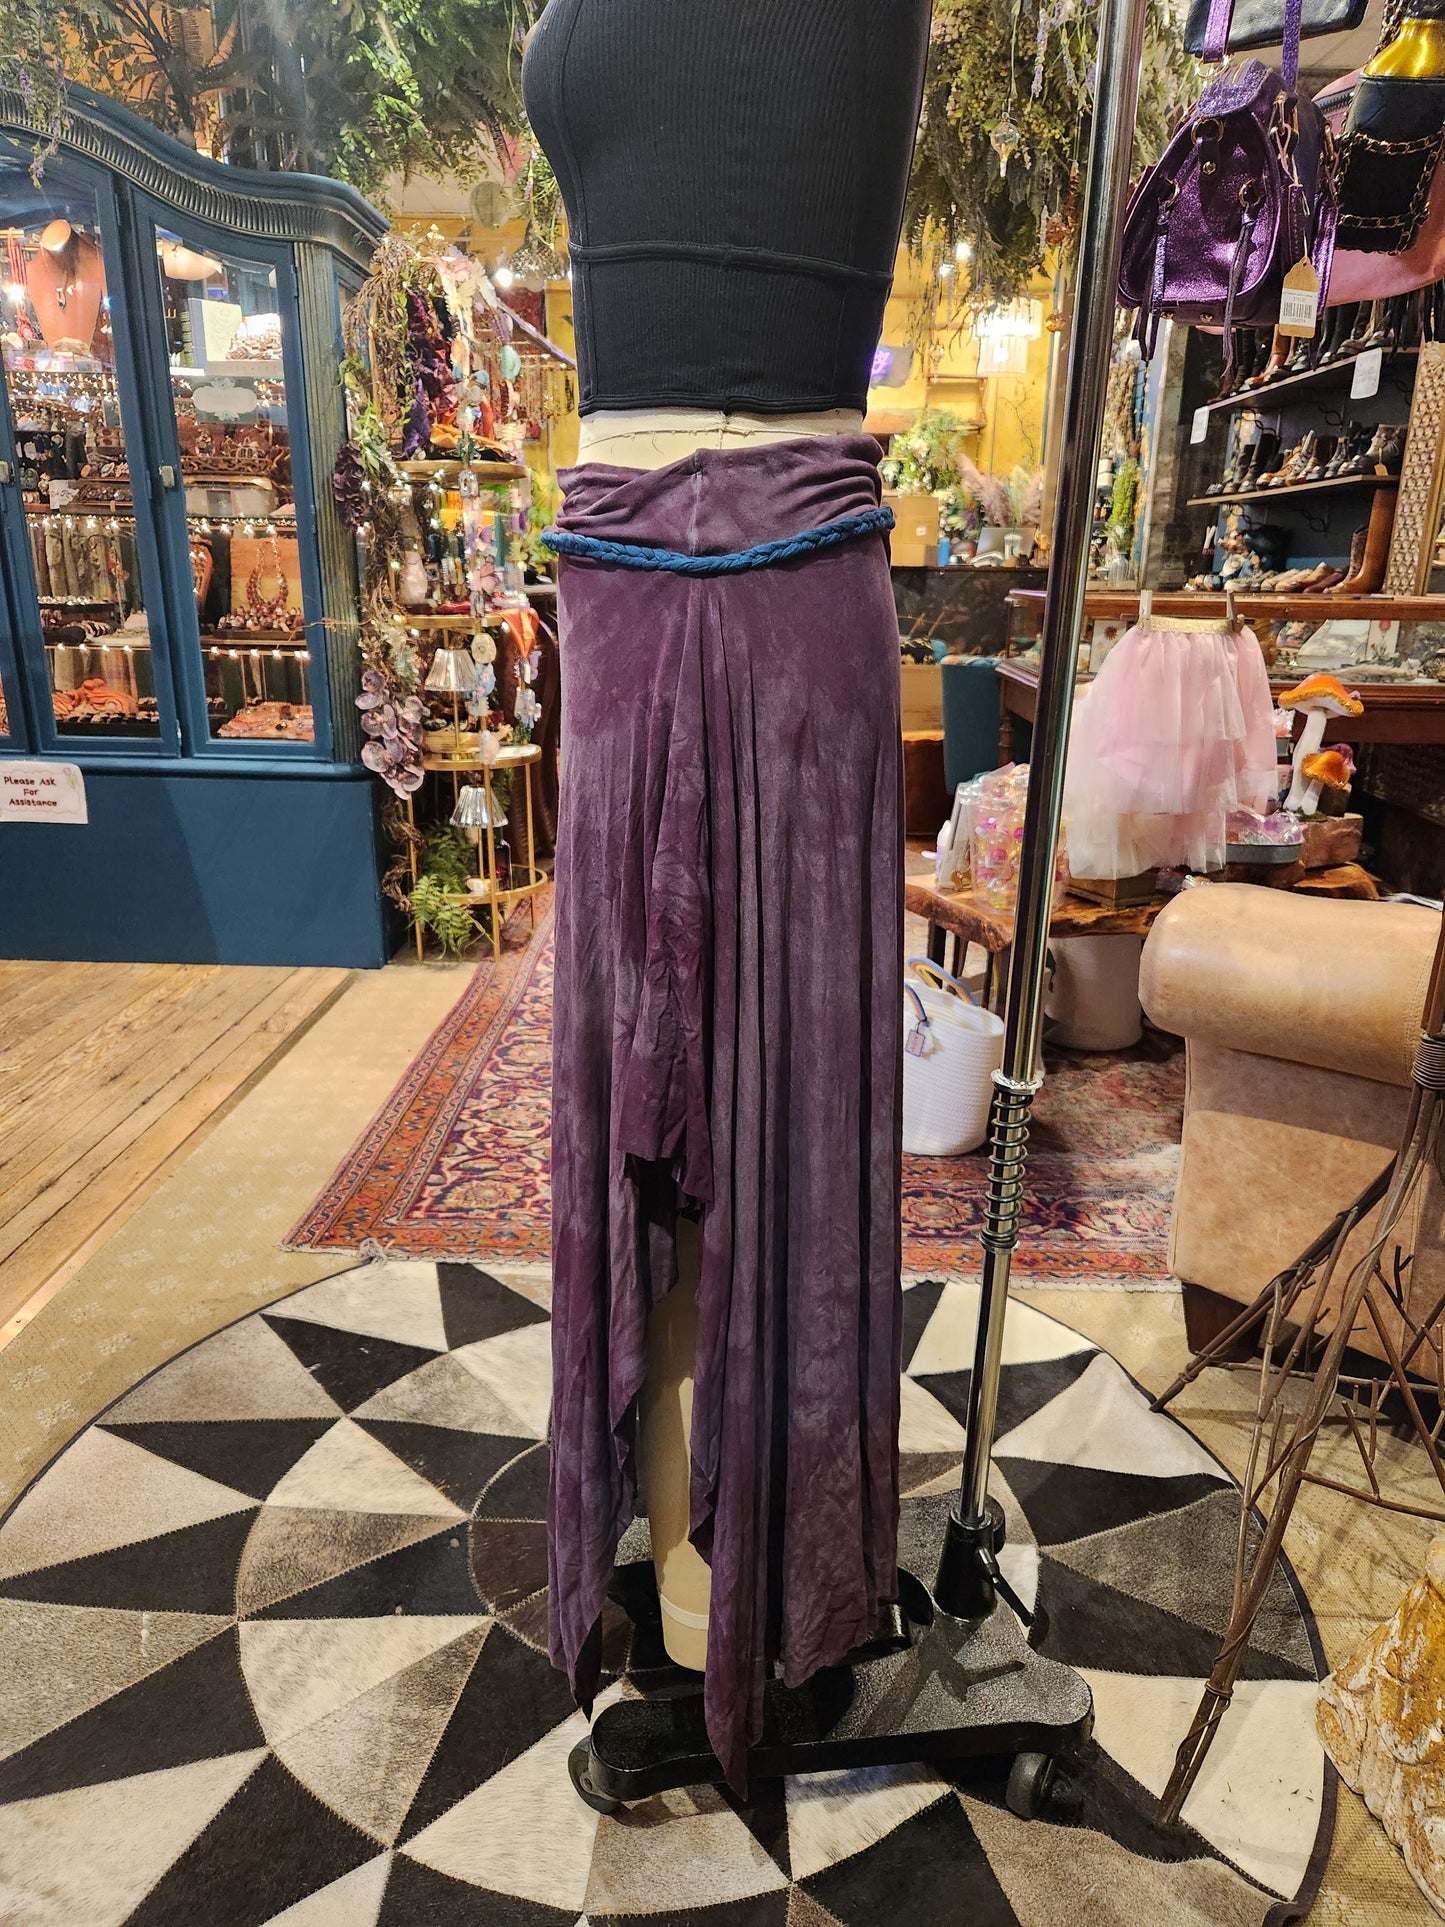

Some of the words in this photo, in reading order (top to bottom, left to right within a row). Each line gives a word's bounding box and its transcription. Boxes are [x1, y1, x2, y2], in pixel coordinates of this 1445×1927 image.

[4, 776, 35, 785] Please
[40, 777, 56, 786] Ask
[23, 788, 39, 796] For
[9, 798, 57, 807] Assistance
